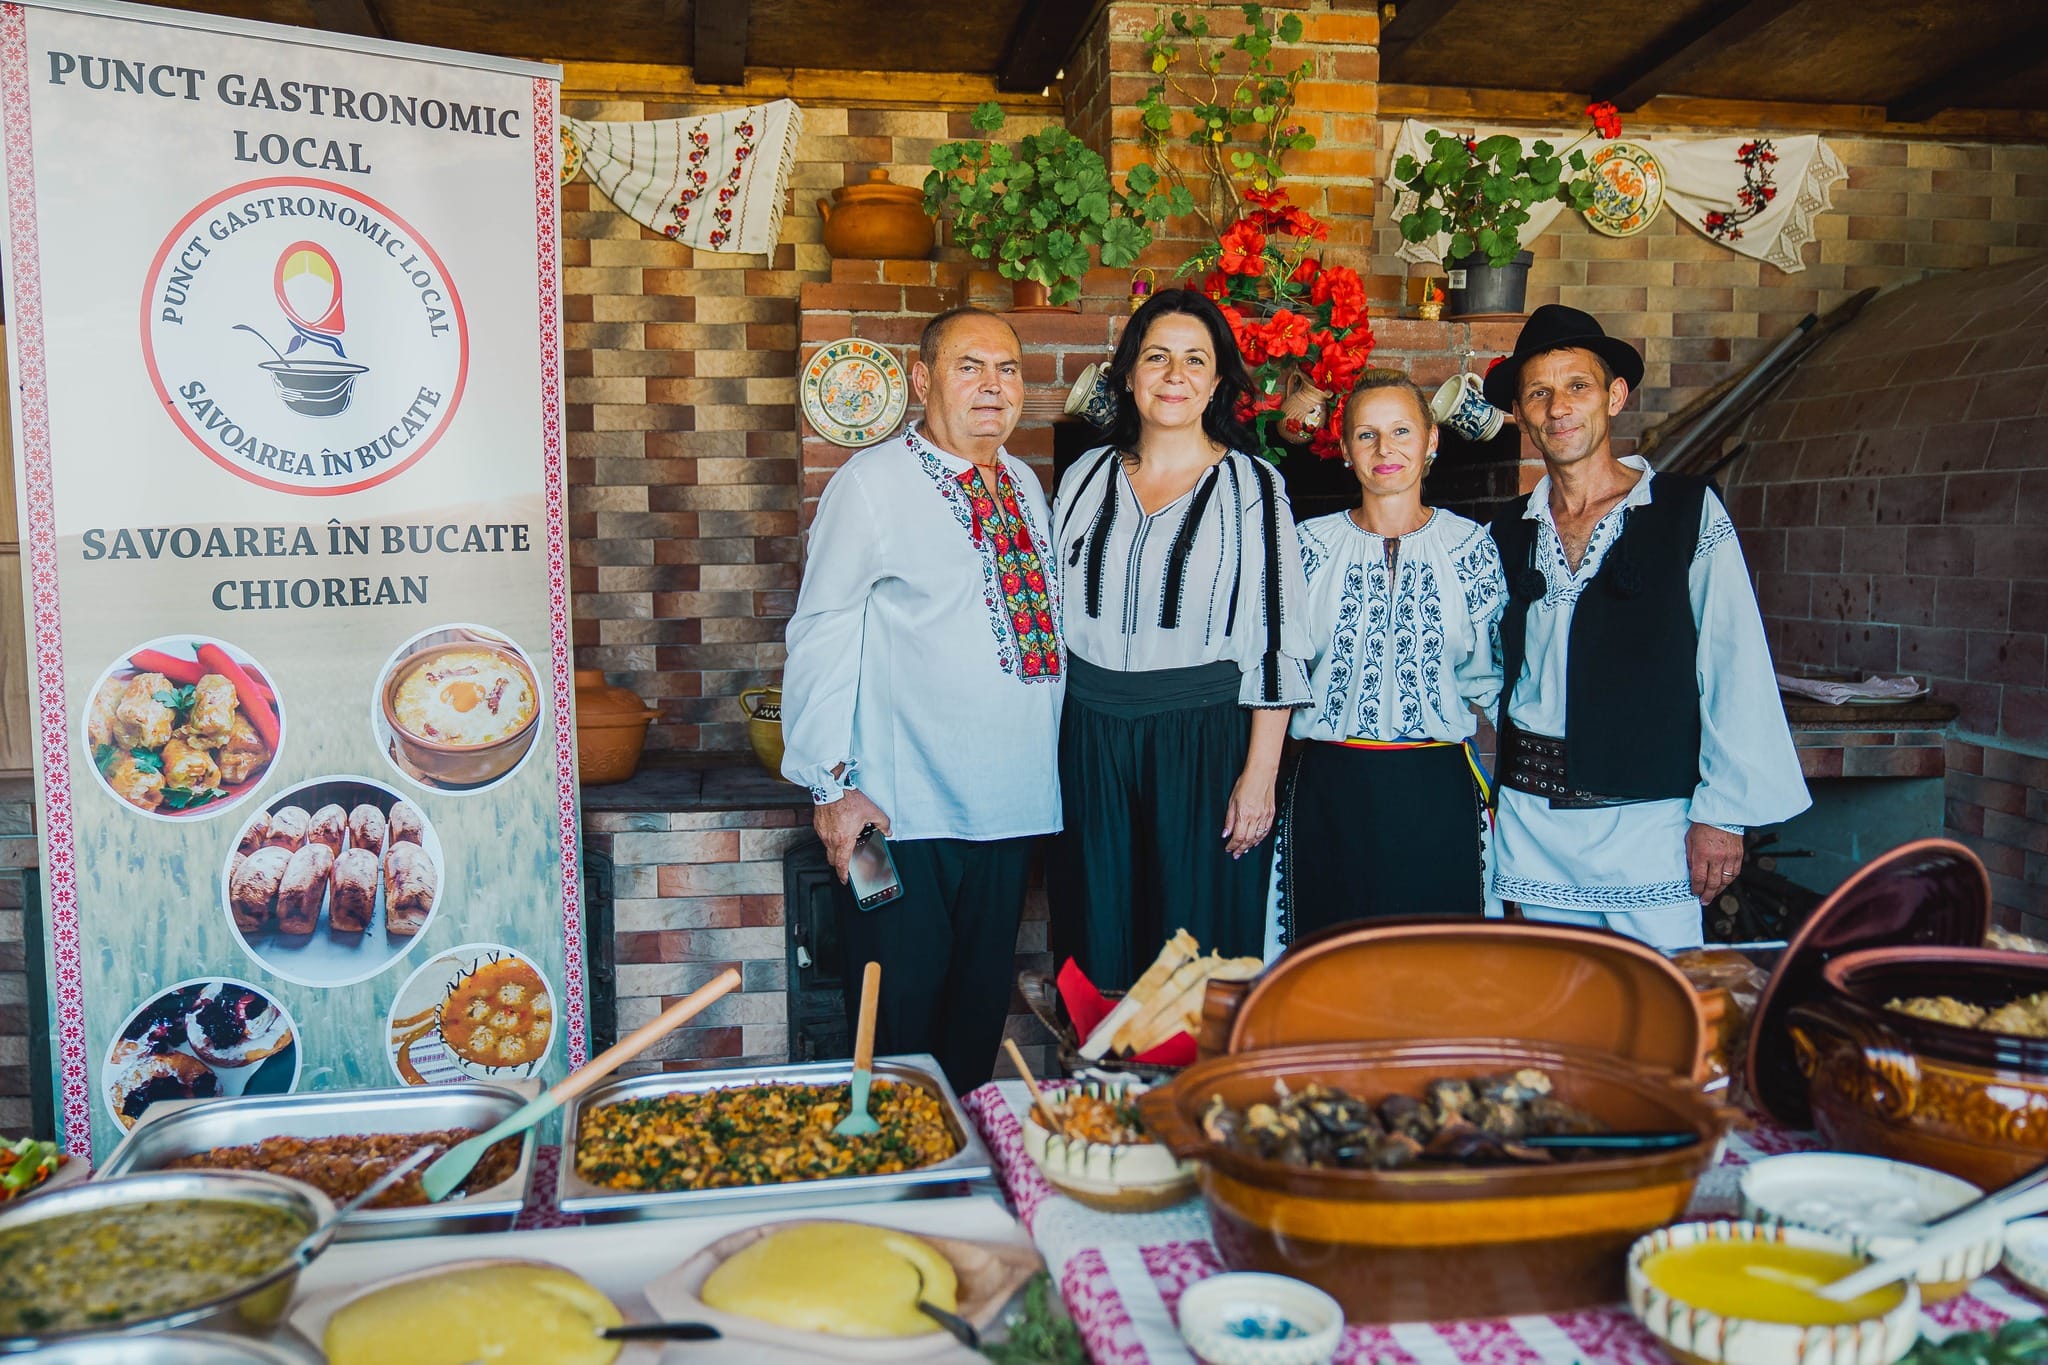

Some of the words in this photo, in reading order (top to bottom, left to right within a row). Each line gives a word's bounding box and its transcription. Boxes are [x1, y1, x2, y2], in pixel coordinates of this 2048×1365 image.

[47, 51, 205, 101] PUNCT
[217, 73, 521, 139] GASTRONOMIC
[233, 130, 372, 174] LOCAL
[162, 236, 210, 325] PUNCT
[209, 196, 405, 258] GASTRONOMIC
[400, 254, 449, 338] LOCAL
[179, 380, 316, 476] SAVOAREA
[320, 448, 352, 476] ÎN
[355, 386, 442, 470] BUCATE
[82, 526, 319, 560] SAVOAREA
[327, 518, 370, 556] ÎN
[381, 523, 531, 554] BUCATE
[212, 575, 429, 611] CHIOREAN
